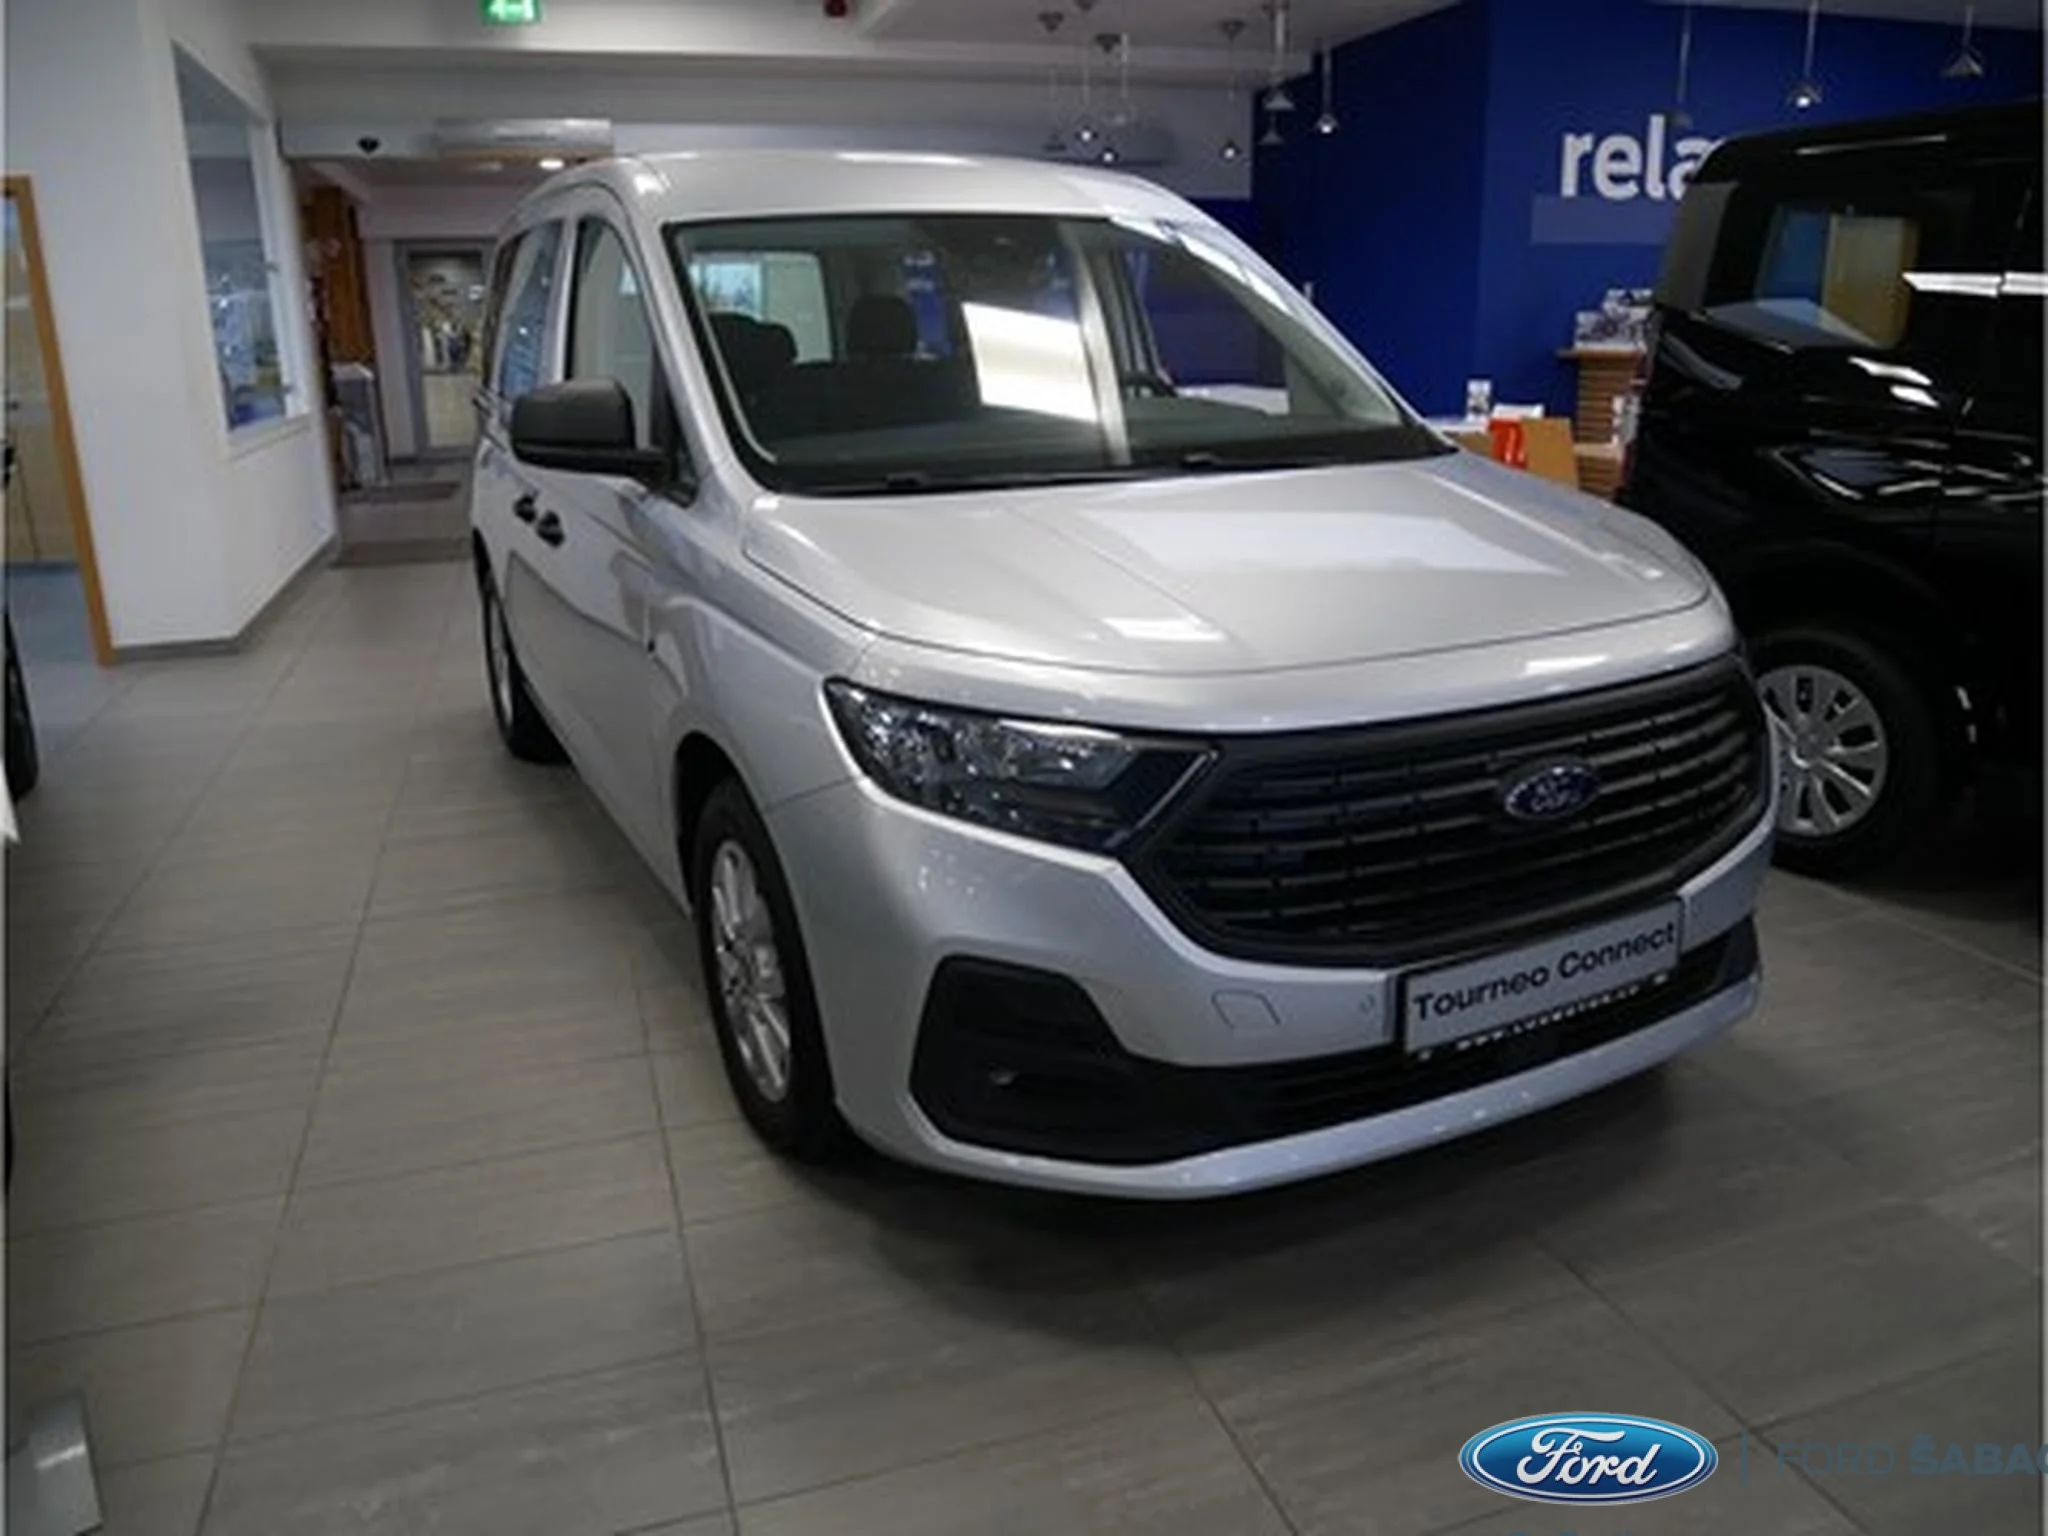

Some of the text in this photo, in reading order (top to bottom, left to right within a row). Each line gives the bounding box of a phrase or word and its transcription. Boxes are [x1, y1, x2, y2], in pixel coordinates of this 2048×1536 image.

[1560, 114, 1726, 200] rela
[1413, 965, 1550, 1021] Tourneo
[1557, 922, 1675, 979] Connect
